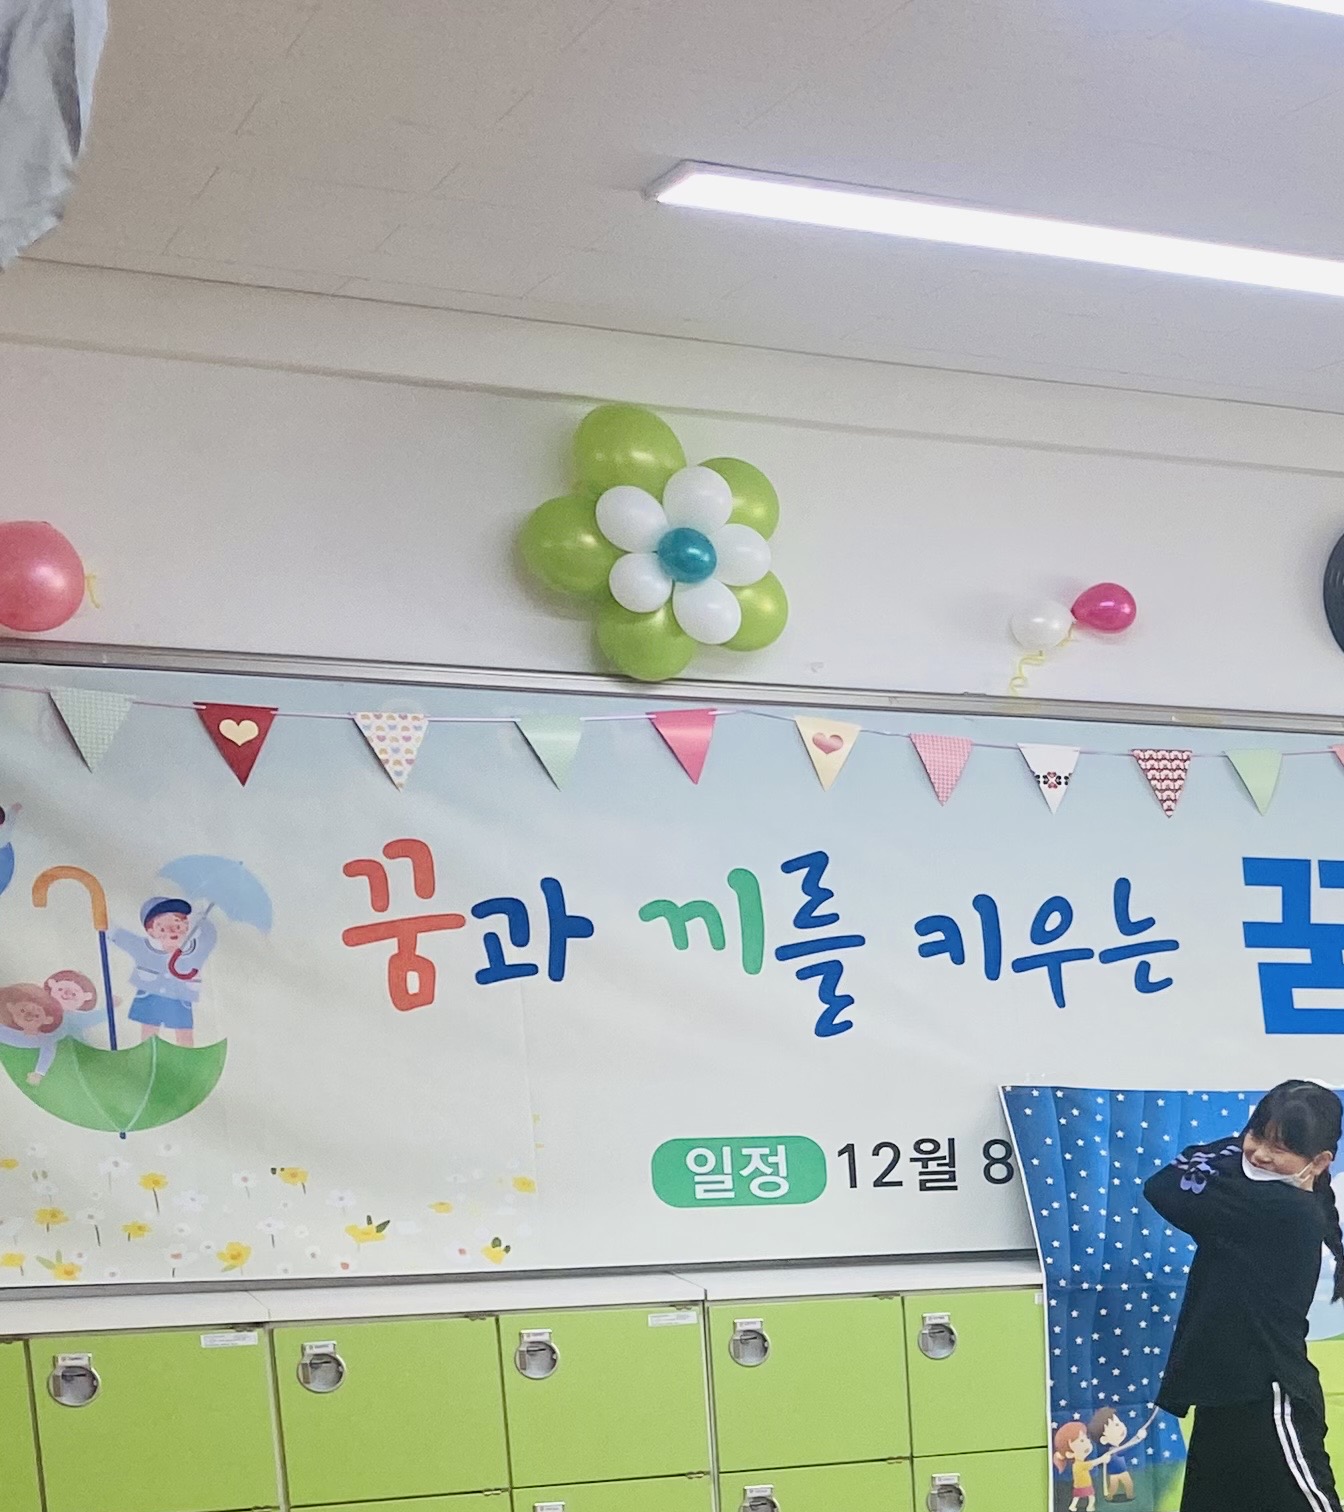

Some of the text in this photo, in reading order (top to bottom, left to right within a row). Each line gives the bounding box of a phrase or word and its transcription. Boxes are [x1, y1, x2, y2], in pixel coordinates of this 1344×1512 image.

[342, 837, 594, 1012] 꿈과
[638, 850, 866, 1037] 끼를
[914, 877, 1180, 1009] 키우는
[685, 1137, 1014, 1199] 일정 12월 8
